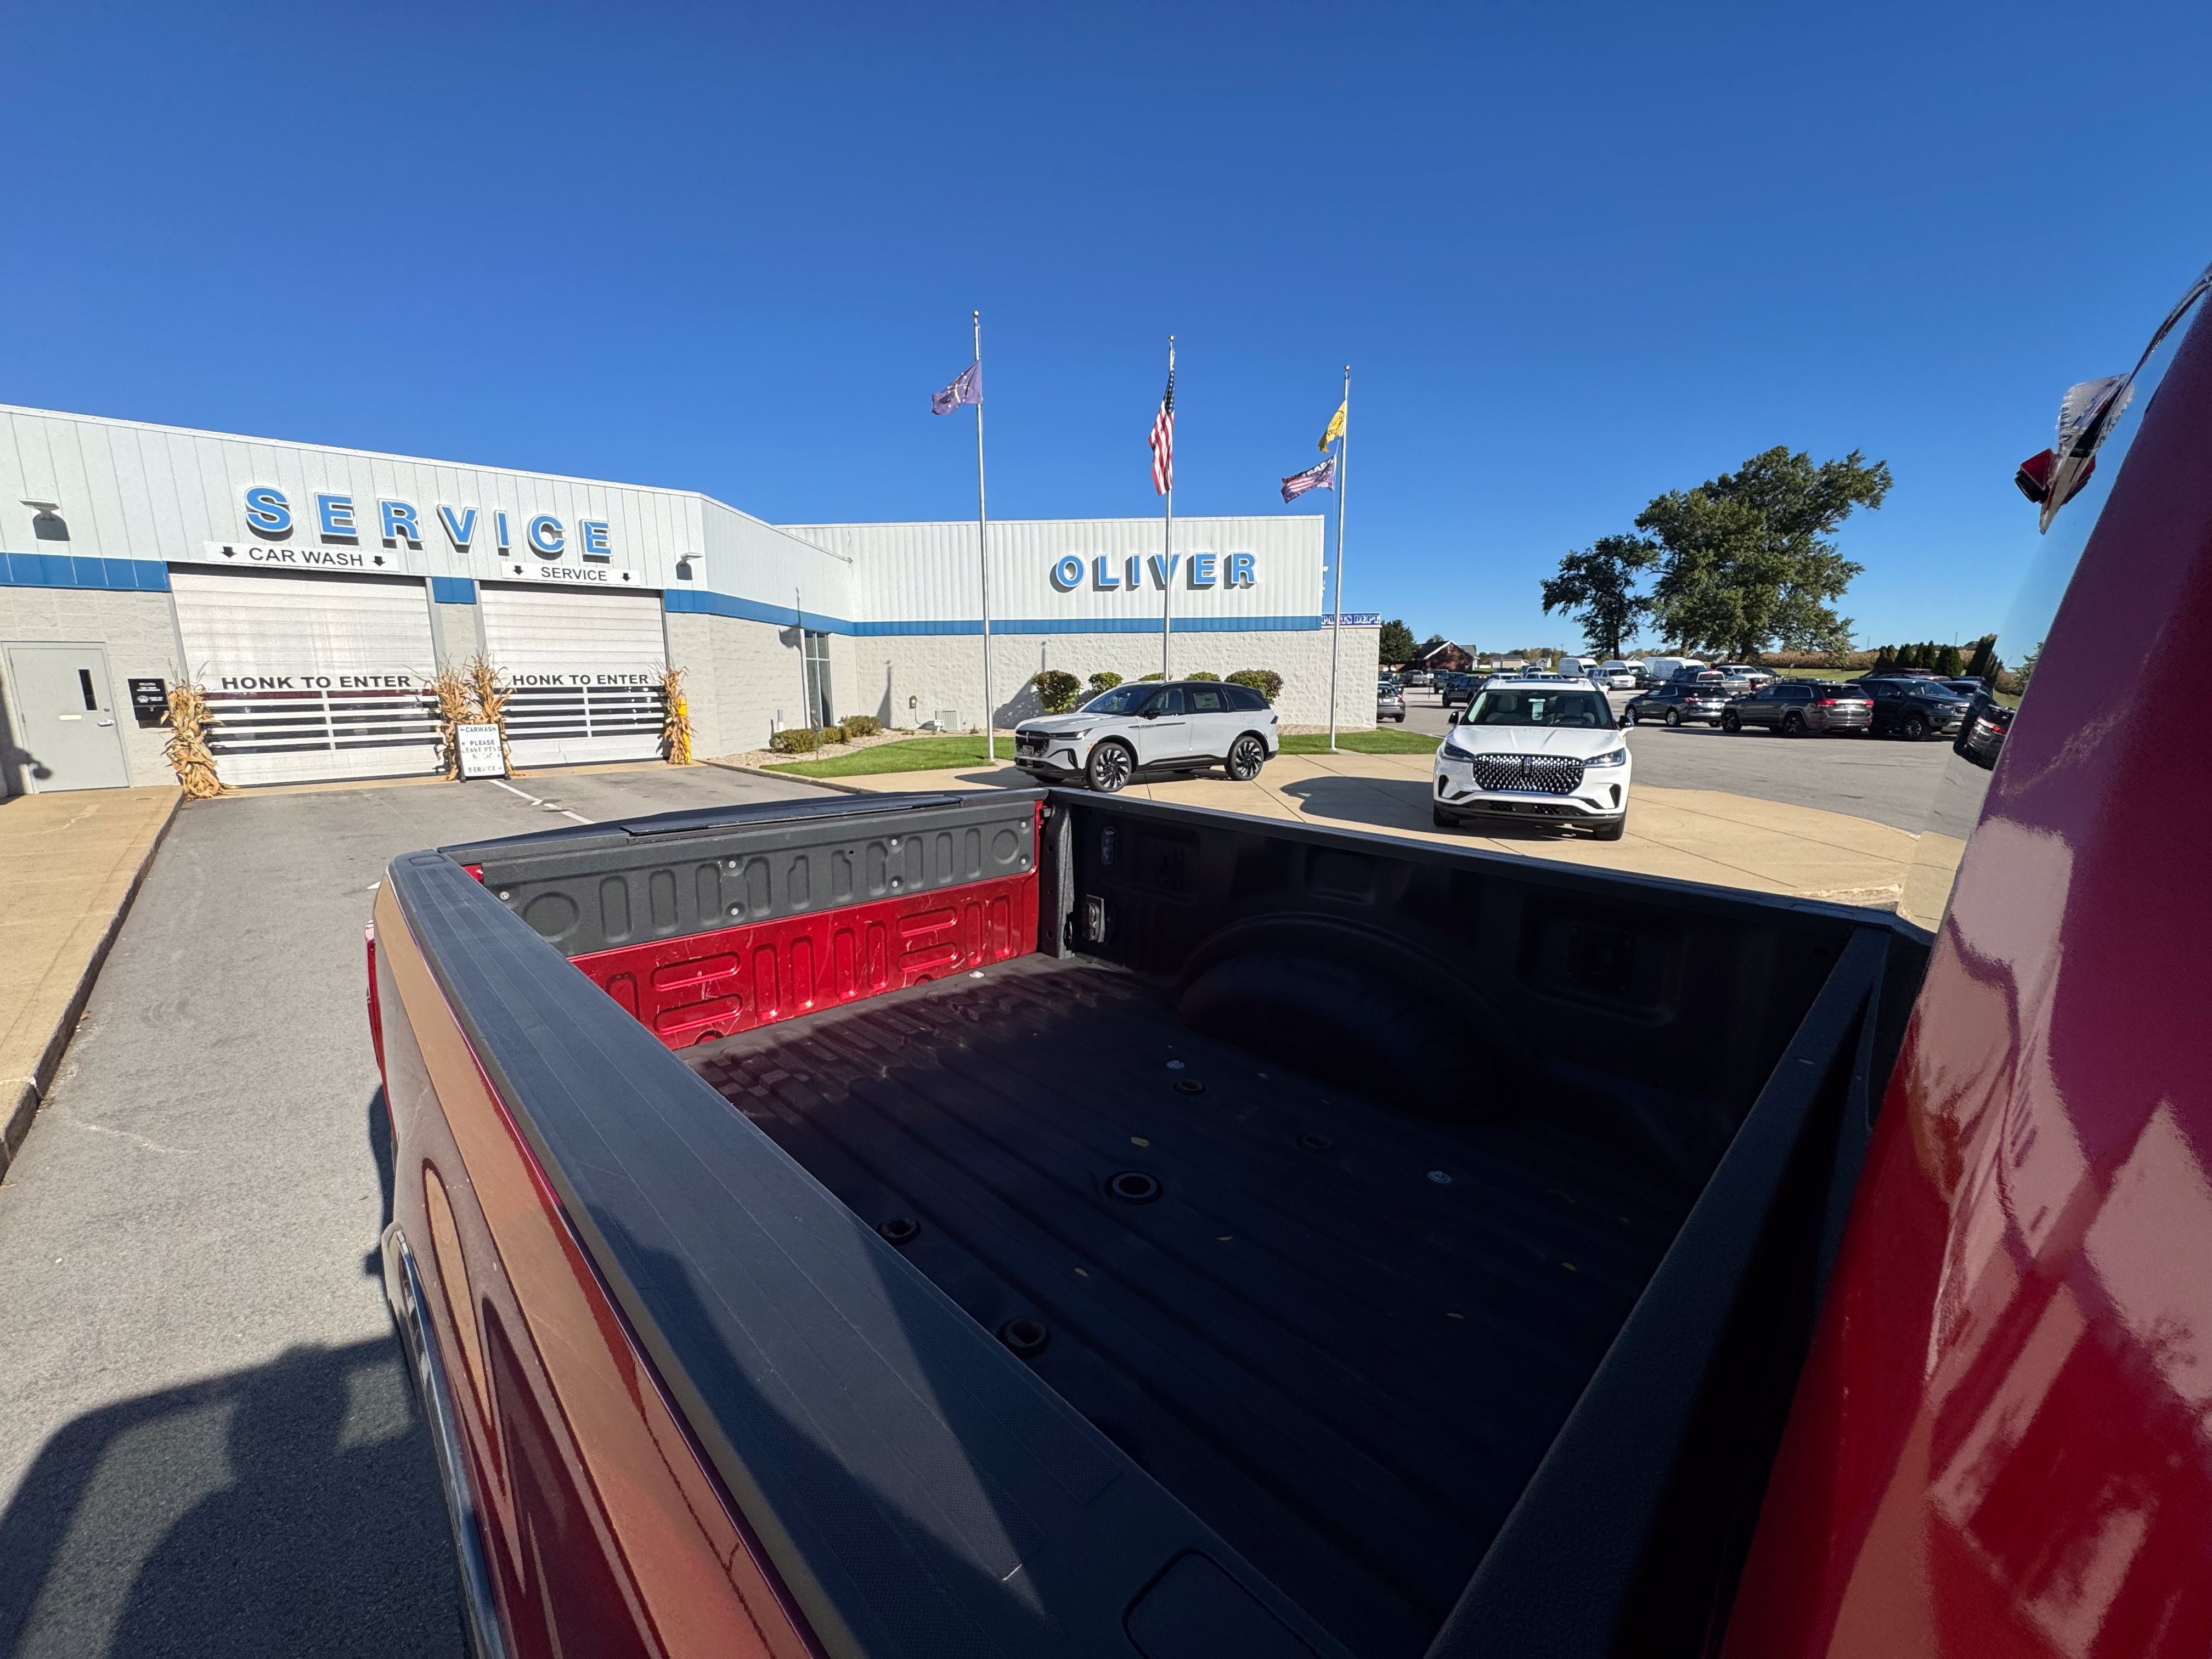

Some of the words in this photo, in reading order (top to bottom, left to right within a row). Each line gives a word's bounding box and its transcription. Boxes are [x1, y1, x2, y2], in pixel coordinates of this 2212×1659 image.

[245, 485, 613, 557] SERVICE
[249, 548, 296, 562] CAR
[302, 551, 363, 566] WASH
[541, 567, 607, 581] SERVICE
[1055, 551, 1257, 588] OLIVER
[1321, 614, 1352, 625] PATS
[1353, 614, 1380, 624] DEPT
[222, 677, 294, 690] HONK
[300, 676, 331, 689] TO
[339, 676, 411, 687] ENTER
[512, 675, 564, 685] HONK
[569, 675, 591, 685] TO
[597, 674, 649, 684] ENTER
